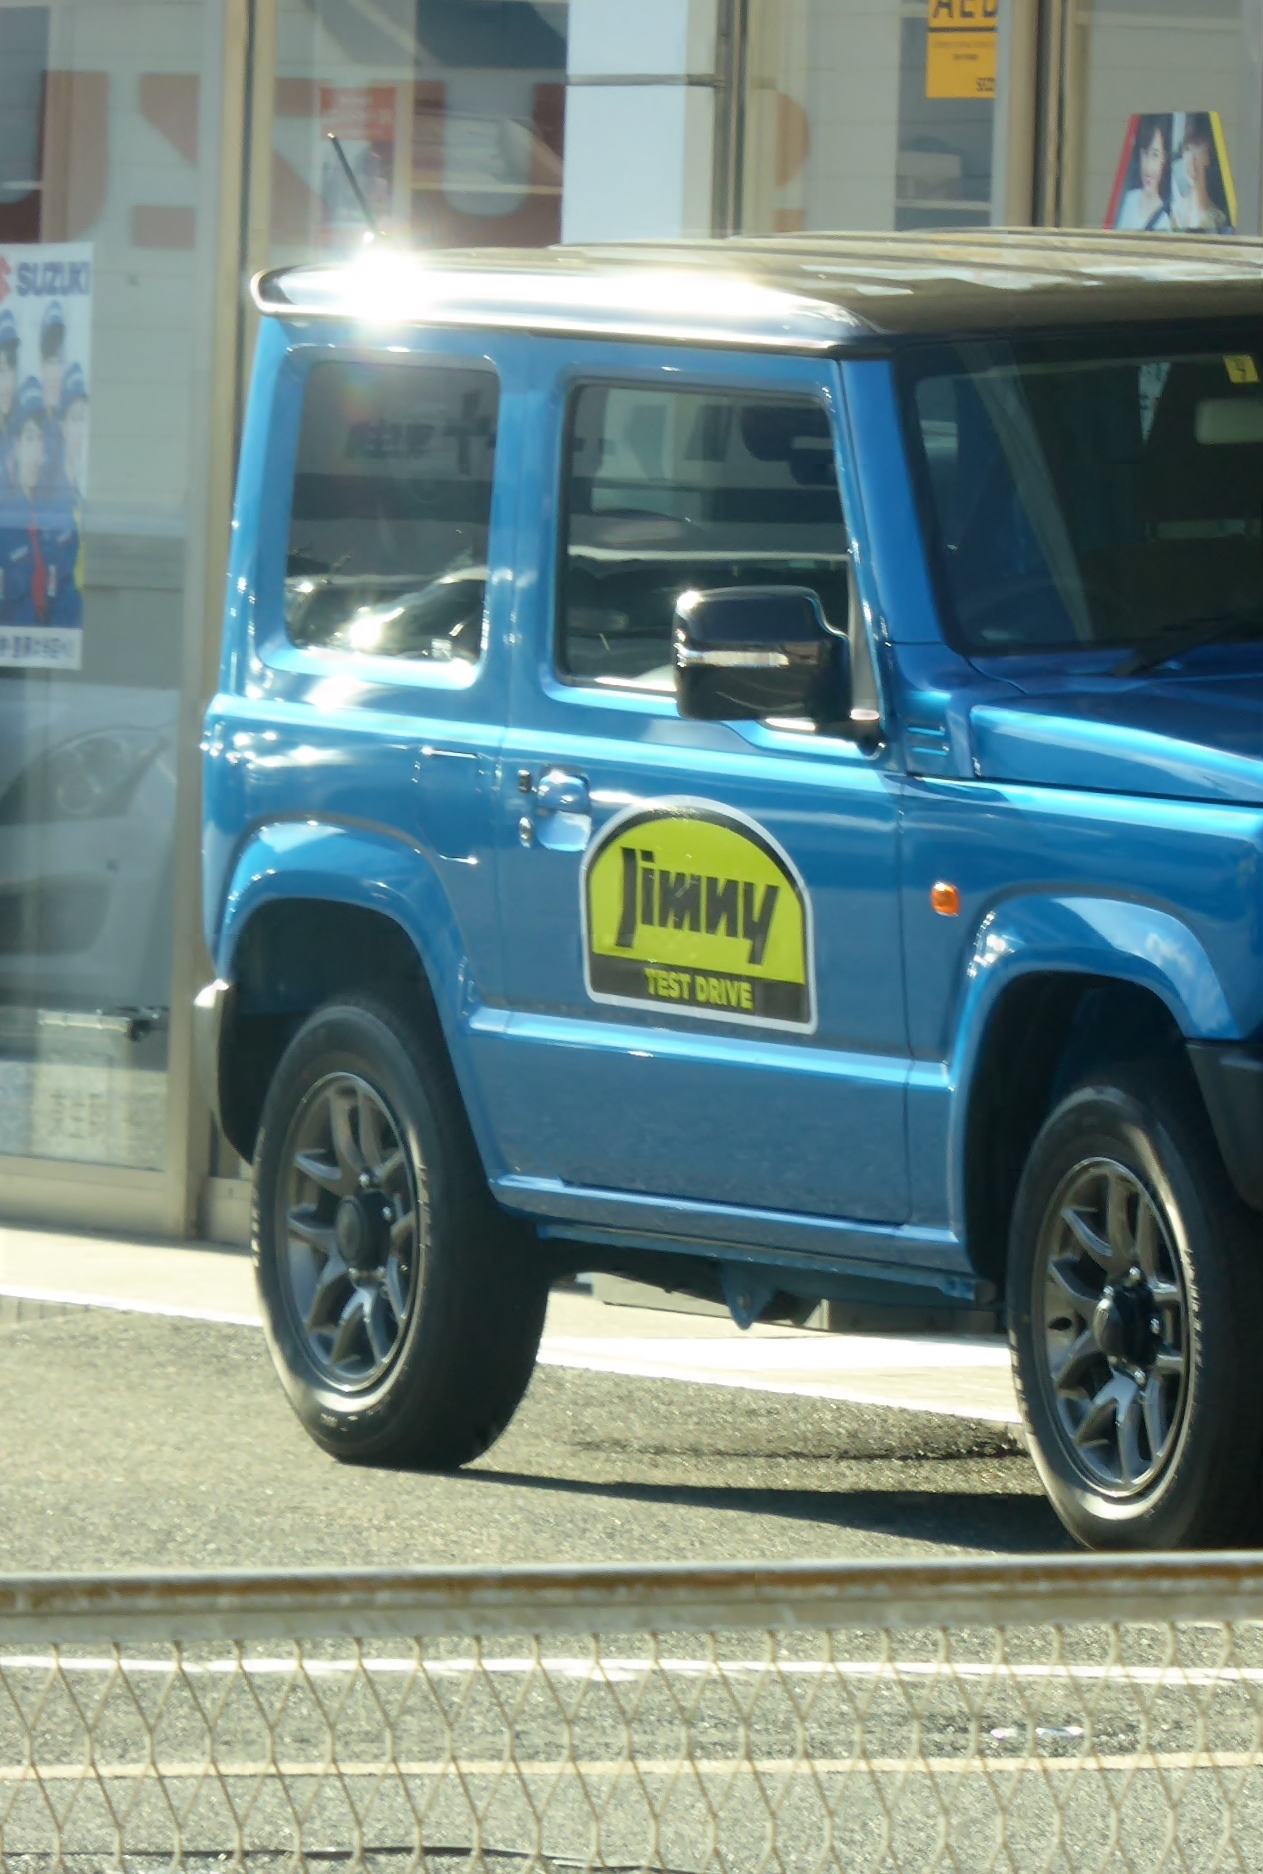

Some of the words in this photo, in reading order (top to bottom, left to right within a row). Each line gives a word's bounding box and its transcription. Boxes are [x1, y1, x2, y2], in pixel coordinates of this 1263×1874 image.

[16, 262, 91, 297] SUZUKI
[616, 847, 780, 965] Jimny
[644, 969, 691, 999] TEST
[695, 976, 754, 1010] DRIVE
